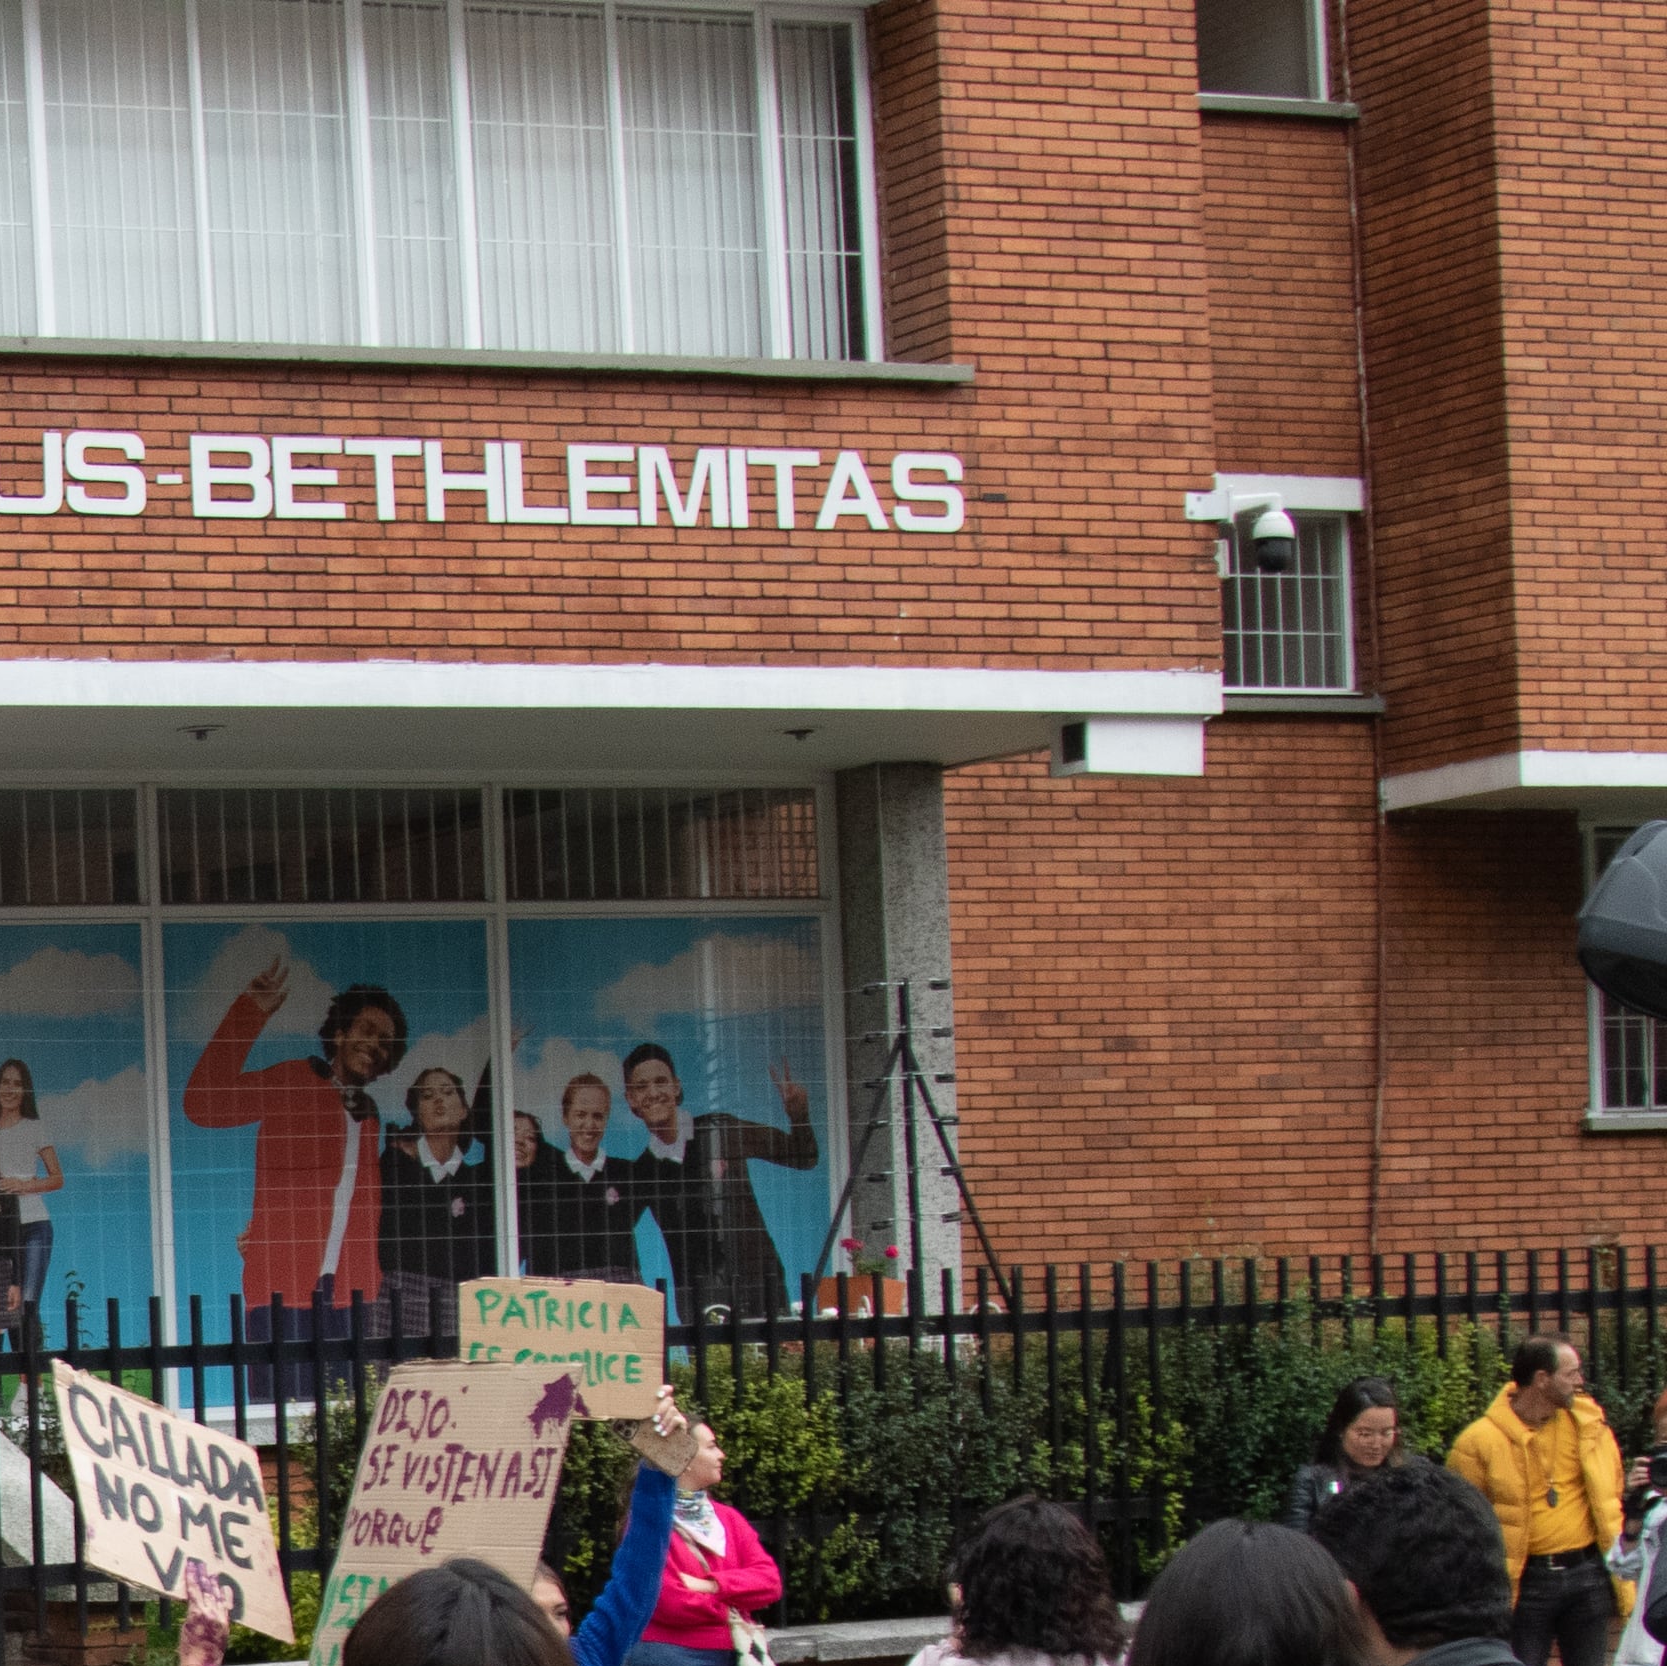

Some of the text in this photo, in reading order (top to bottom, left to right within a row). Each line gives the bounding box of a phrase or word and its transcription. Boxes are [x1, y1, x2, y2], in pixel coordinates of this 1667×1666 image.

[475, 1289, 642, 1333] PATRICIA
[68, 1384, 264, 1513] CALLADA
[363, 1444, 400, 1491] SE
[93, 1462, 254, 1570] NO ME
